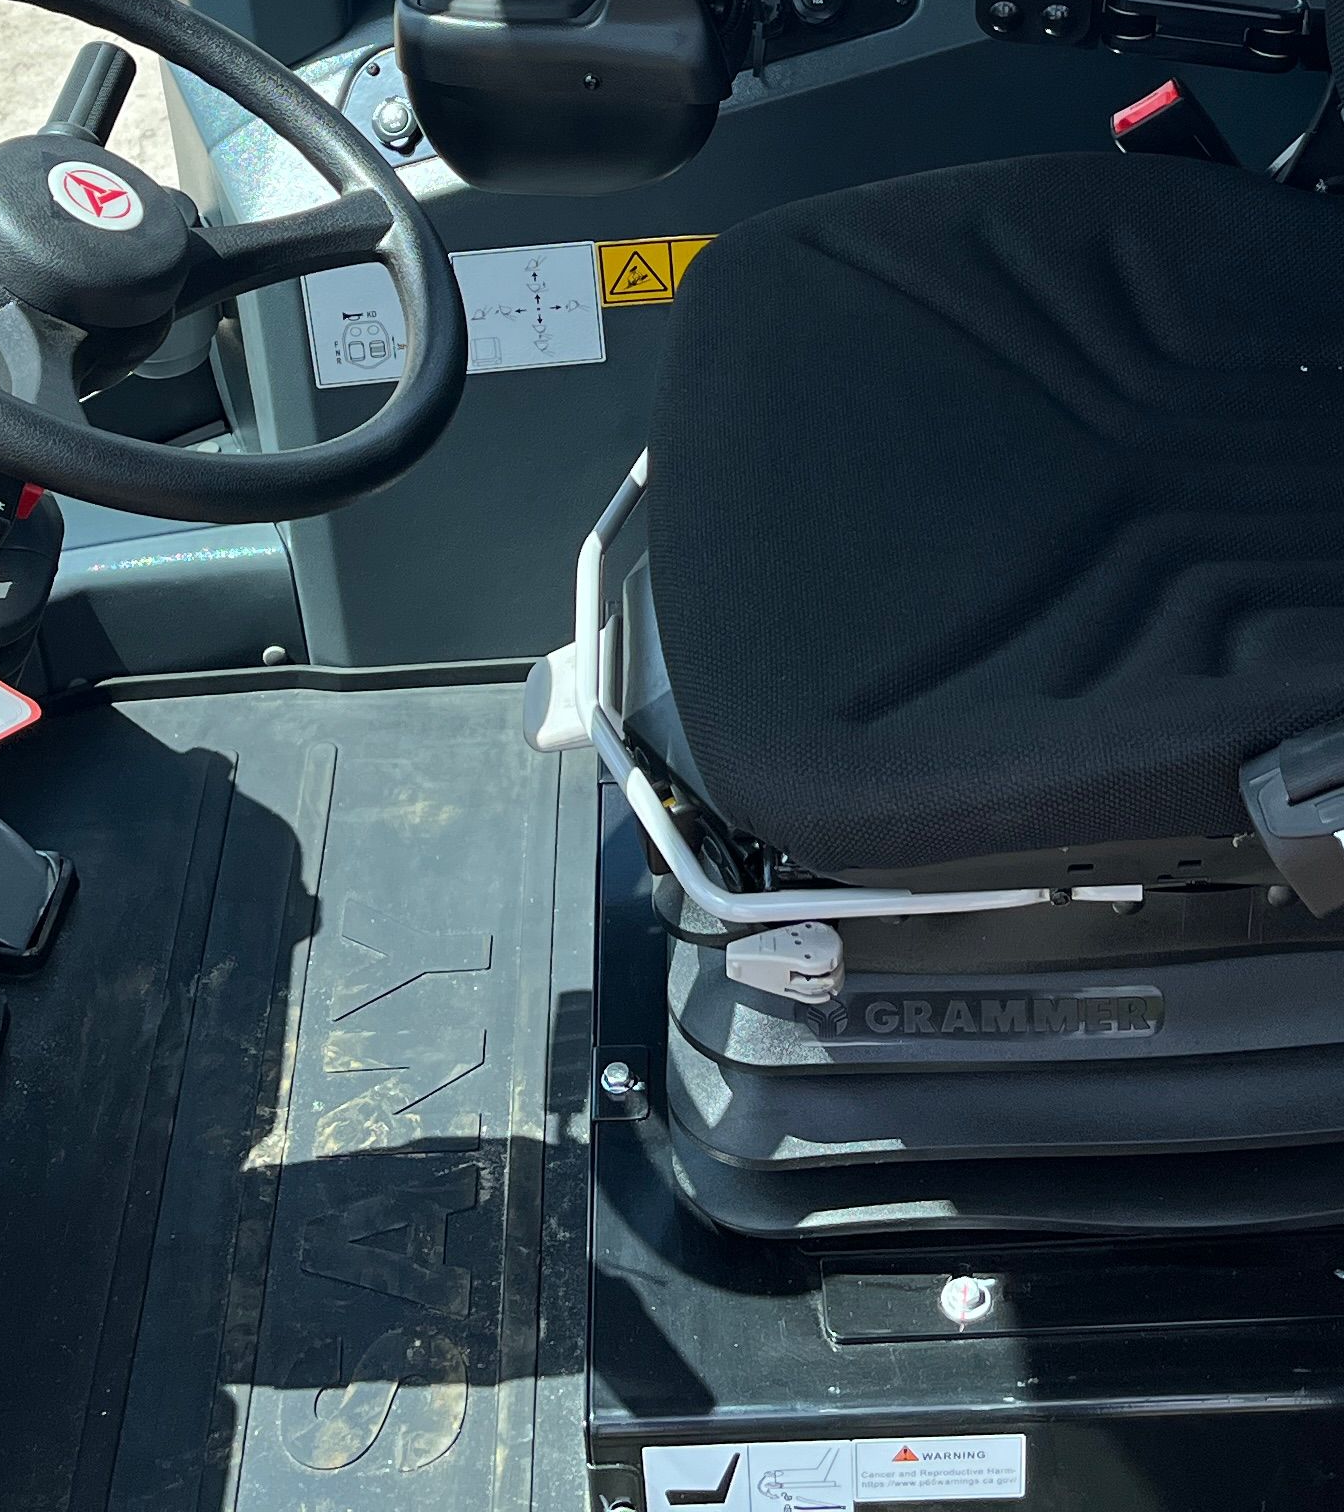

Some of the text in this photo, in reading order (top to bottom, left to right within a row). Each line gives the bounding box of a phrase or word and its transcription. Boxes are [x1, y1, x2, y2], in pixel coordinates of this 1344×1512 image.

[864, 996, 1152, 1036] GRAMMER
[280, 895, 494, 1473] SANY
[922, 1450, 987, 1461] WARNING
[860, 1470, 896, 1479] Cancer
[899, 1469, 917, 1478] and
[919, 1467, 984, 1479] Reproductive
